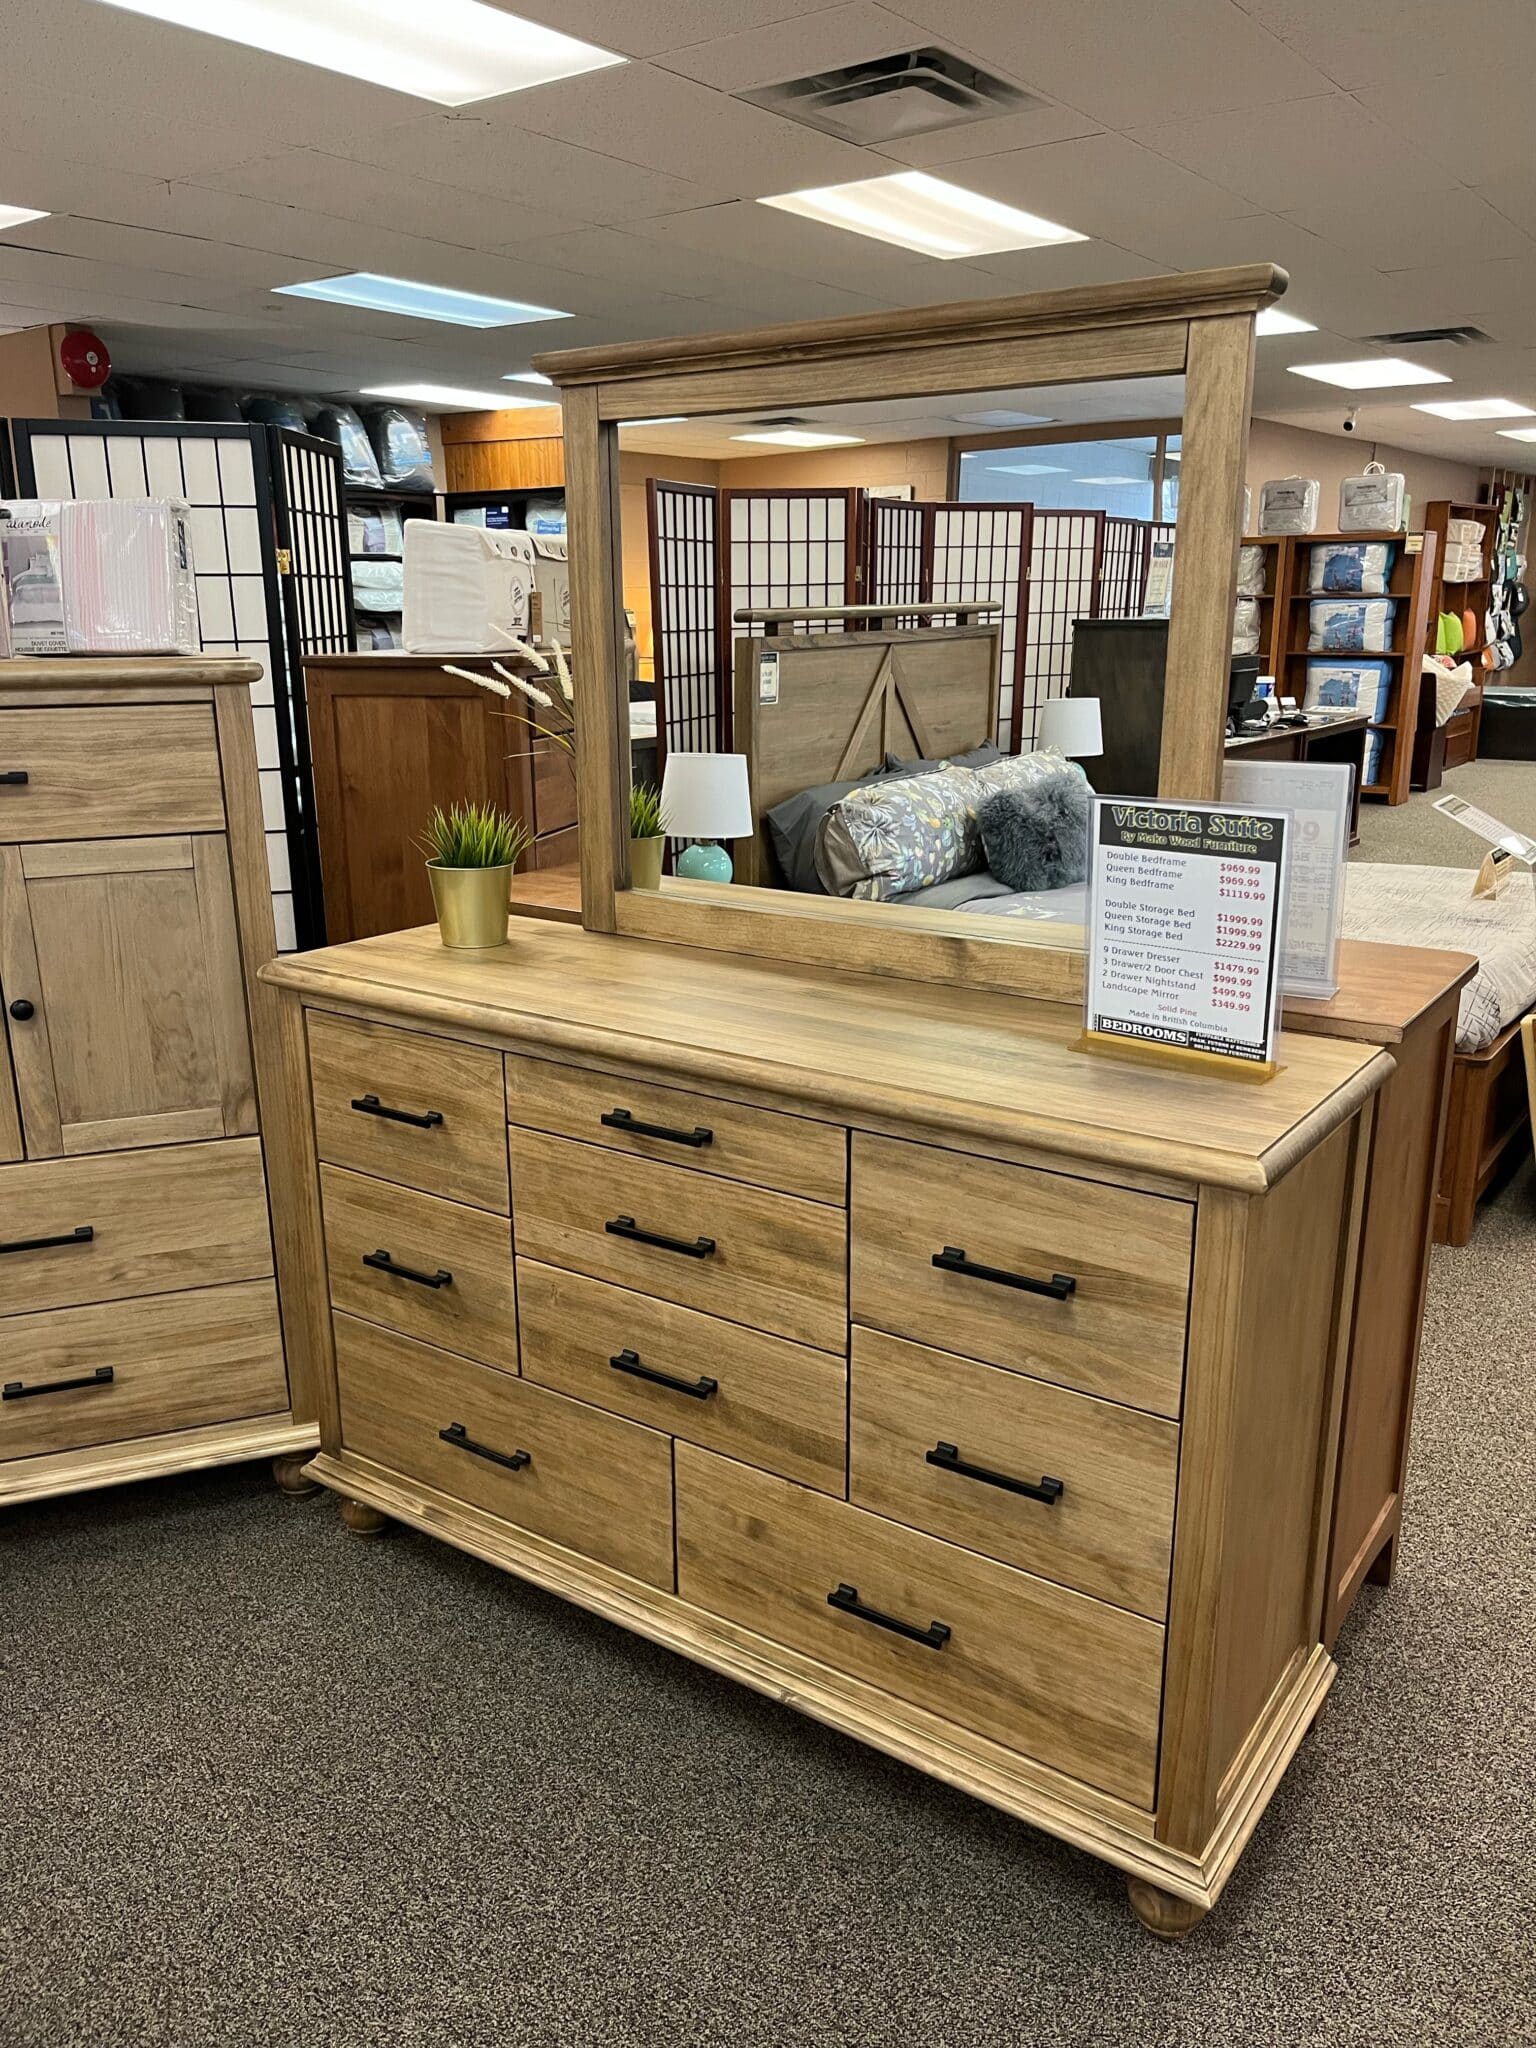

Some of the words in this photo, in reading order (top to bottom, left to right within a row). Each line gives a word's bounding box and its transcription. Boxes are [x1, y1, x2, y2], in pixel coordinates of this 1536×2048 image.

[1112, 805, 1202, 833] Victoria
[1208, 815, 1273, 840] Suite
[1120, 830, 1136, 843] By
[1169, 835, 1200, 848] Wood
[1203, 838, 1258, 854] Furniture
[1106, 863, 1135, 874] Queen
[1138, 866, 1183, 879] Bedframe
[1219, 875, 1260, 888] $969.99
[1107, 851, 1139, 862] Double
[1141, 855, 1186, 867] Bedframe
[1220, 863, 1261, 875] $969.99
[1106, 875, 1127, 886] King
[1130, 878, 1175, 891] Bedframe
[1219, 888, 1265, 901] $1119.99
[1104, 911, 1133, 922] Queen
[1136, 915, 1171, 928] Storage
[1173, 920, 1191, 930] Bed
[1216, 925, 1262, 939] $1999.99
[1105, 899, 1137, 911] Double
[1139, 904, 1175, 916] Storage
[1177, 908, 1195, 918] Bed
[1217, 913, 1263, 926] $1999.99
[1104, 923, 1125, 934] King
[1128, 926, 1163, 939] Storage
[1165, 931, 1183, 941] Bed
[1215, 938, 1261, 952] $2229.99
[1103, 945, 1109, 953] 9
[1111, 946, 1144, 958] Drawer
[1146, 951, 1181, 963] Dresser
[1213, 961, 1259, 976] $1479.99
[1103, 957, 1108, 965] 3
[1111, 958, 1151, 972] Drawer/2
[1154, 965, 1176, 976] Door
[1178, 968, 1203, 980] Chest
[1213, 974, 1252, 987] $999.99
[1102, 969, 1108, 977] 2
[1110, 970, 1143, 982] Drawer
[1145, 975, 1196, 991] Nightstand
[1212, 986, 1251, 999] $499.99
[1102, 981, 1148, 996] Landscape
[1150, 988, 1179, 1000] Mirror
[1211, 998, 1250, 1012] $349.99
[1129, 1009, 1151, 1019] Made
[1152, 1013, 1160, 1021] in
[1162, 1014, 1188, 1026] British
[1190, 1020, 1228, 1033] Columbia
[1158, 1004, 1178, 1014] Solid
[1180, 1007, 1198, 1017] Pine
[1102, 1018, 1187, 1042] BEDROOMS
